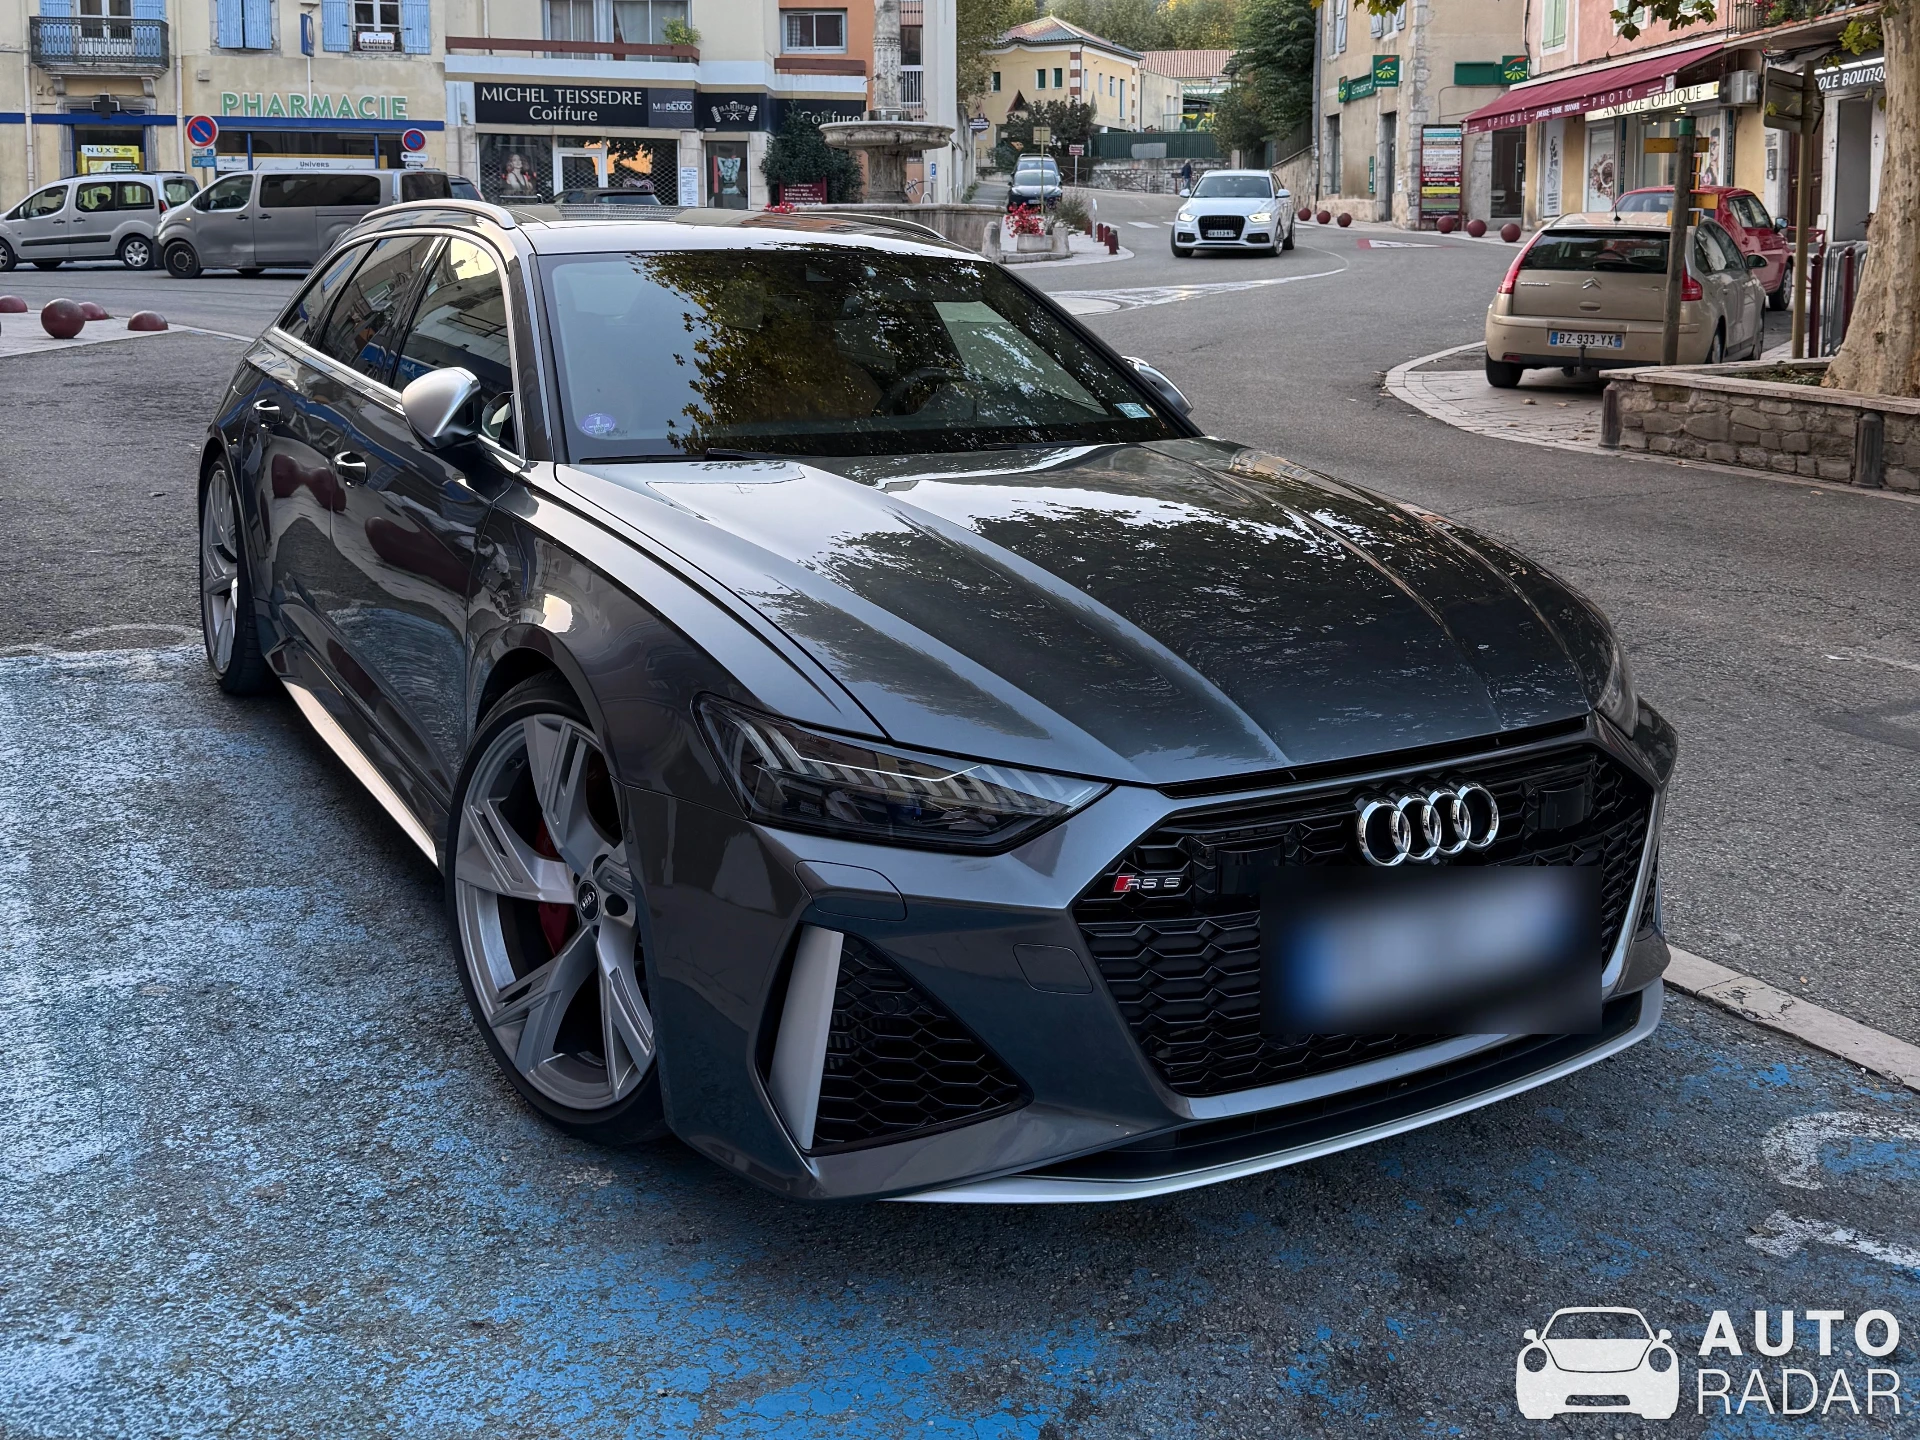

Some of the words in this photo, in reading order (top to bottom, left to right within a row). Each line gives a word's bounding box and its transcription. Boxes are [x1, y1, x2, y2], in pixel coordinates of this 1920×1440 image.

[1816, 74, 1839, 90] OLE
[1841, 66, 1886, 86] BOUTIQ
[221, 92, 408, 120] PHARMACIE
[481, 87, 549, 103] MICHEL
[554, 89, 642, 105] TEISSEDRE
[1487, 111, 1527, 128] OPTIQUE
[1593, 88, 1632, 107] PHOTO
[1602, 100, 1644, 117] ANDUZE
[1651, 86, 1701, 107] OPTIQUE
[529, 106, 598, 121] Coiffure
[1559, 333, 1614, 346] BZ-933-YX
